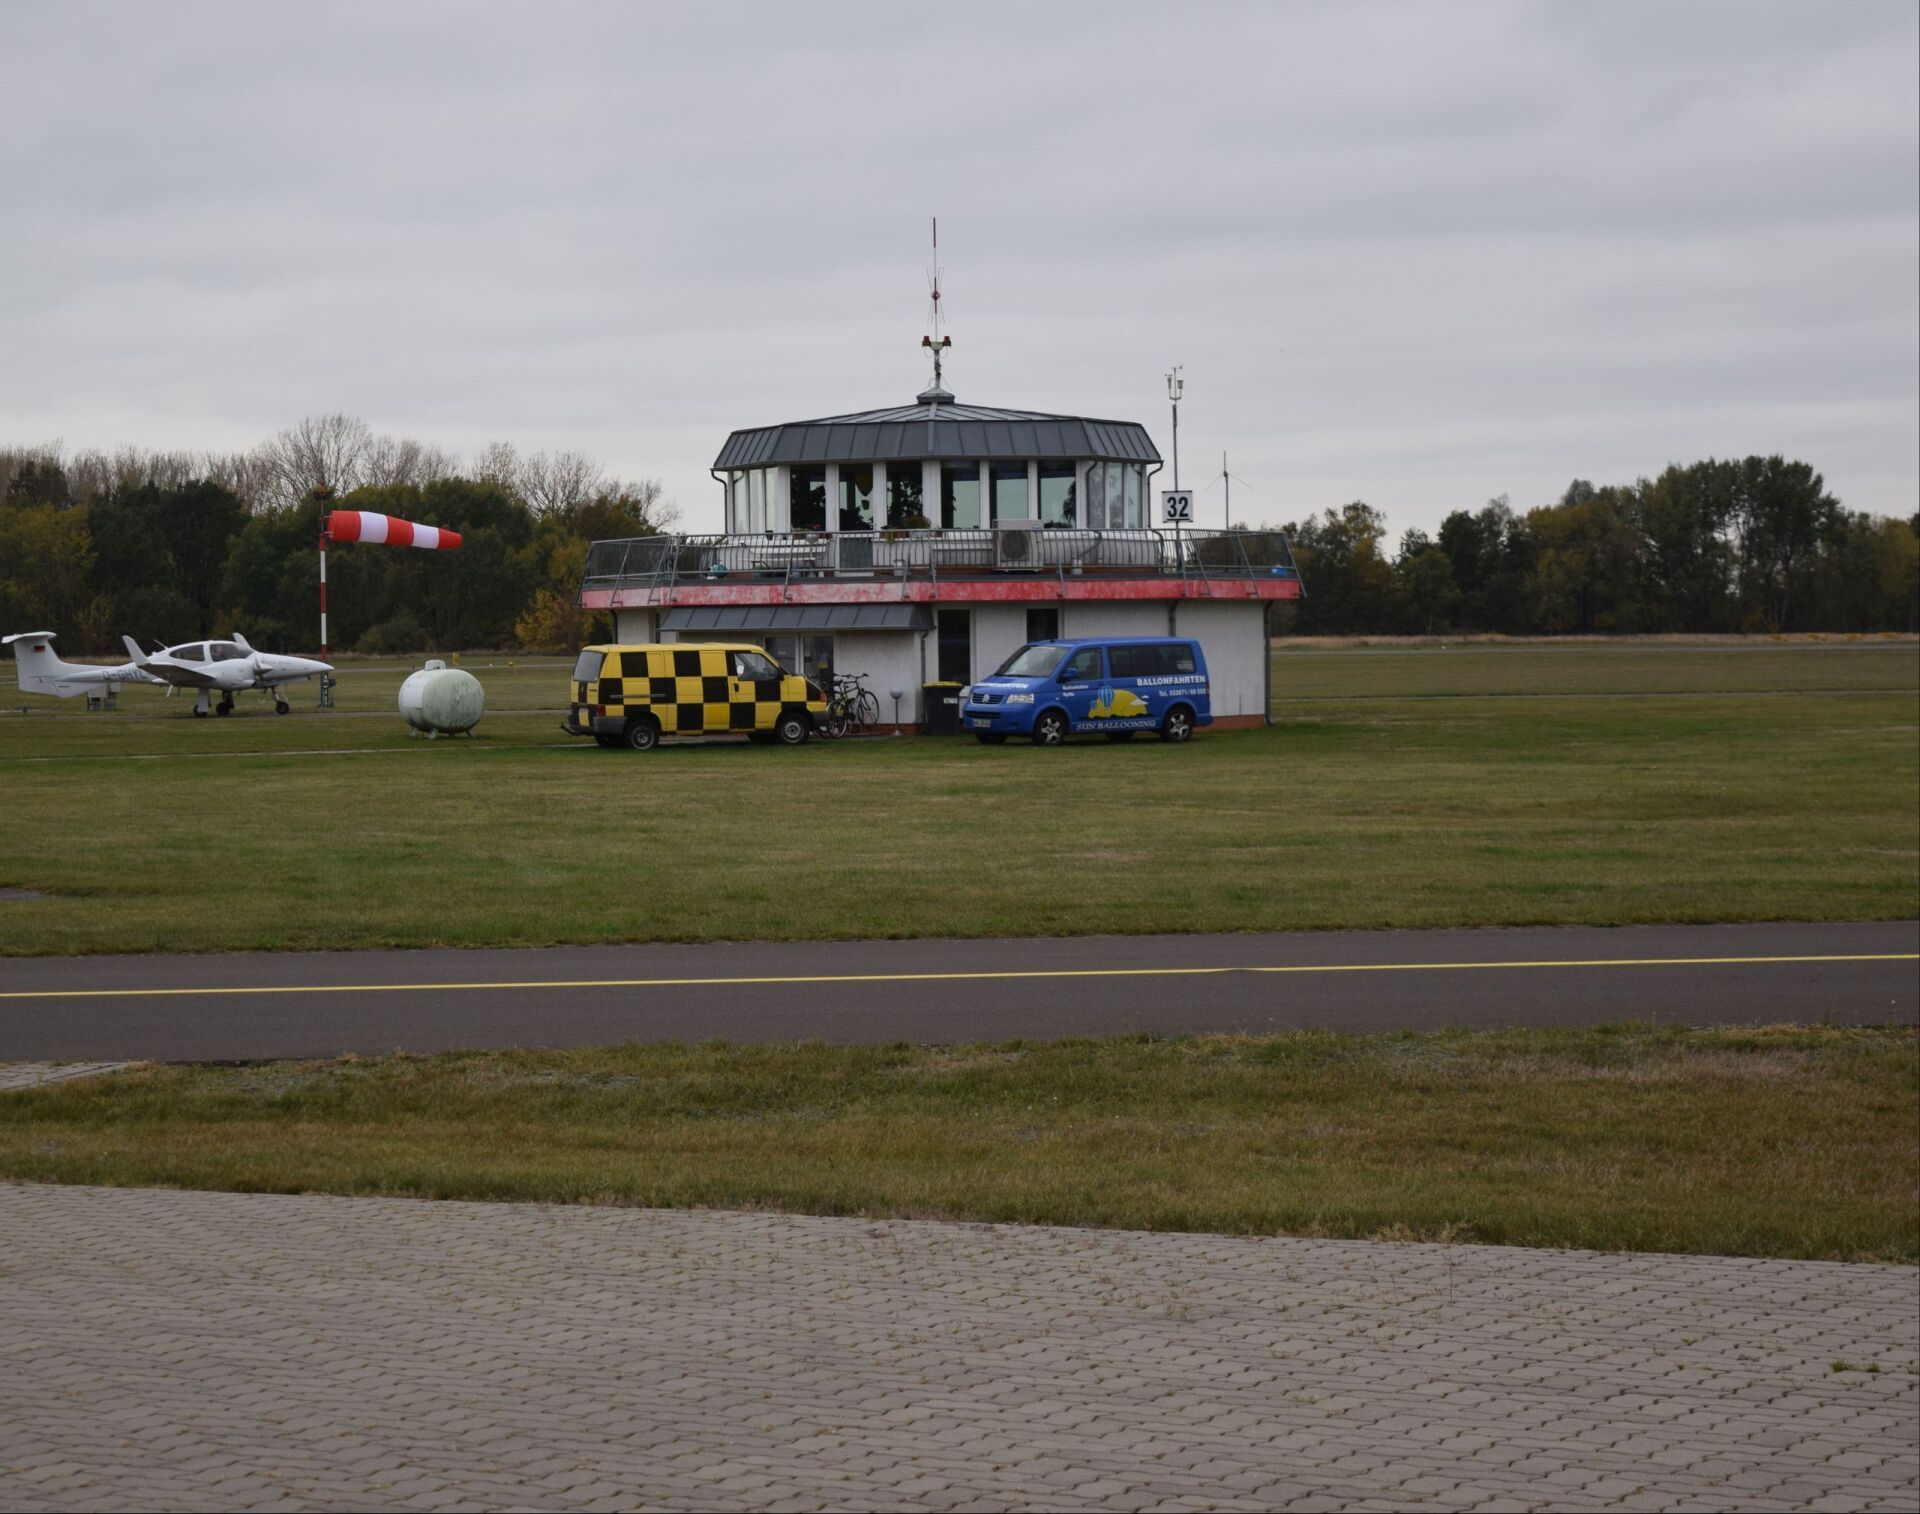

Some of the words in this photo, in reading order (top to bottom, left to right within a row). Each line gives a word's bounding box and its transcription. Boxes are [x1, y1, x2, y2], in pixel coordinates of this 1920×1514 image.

[1167, 496, 1189, 518] 32
[1136, 675, 1206, 687] BALLONFAHRTEN
[1076, 721, 1096, 731] SUN
[1097, 720, 1157, 730] BALLOONING
